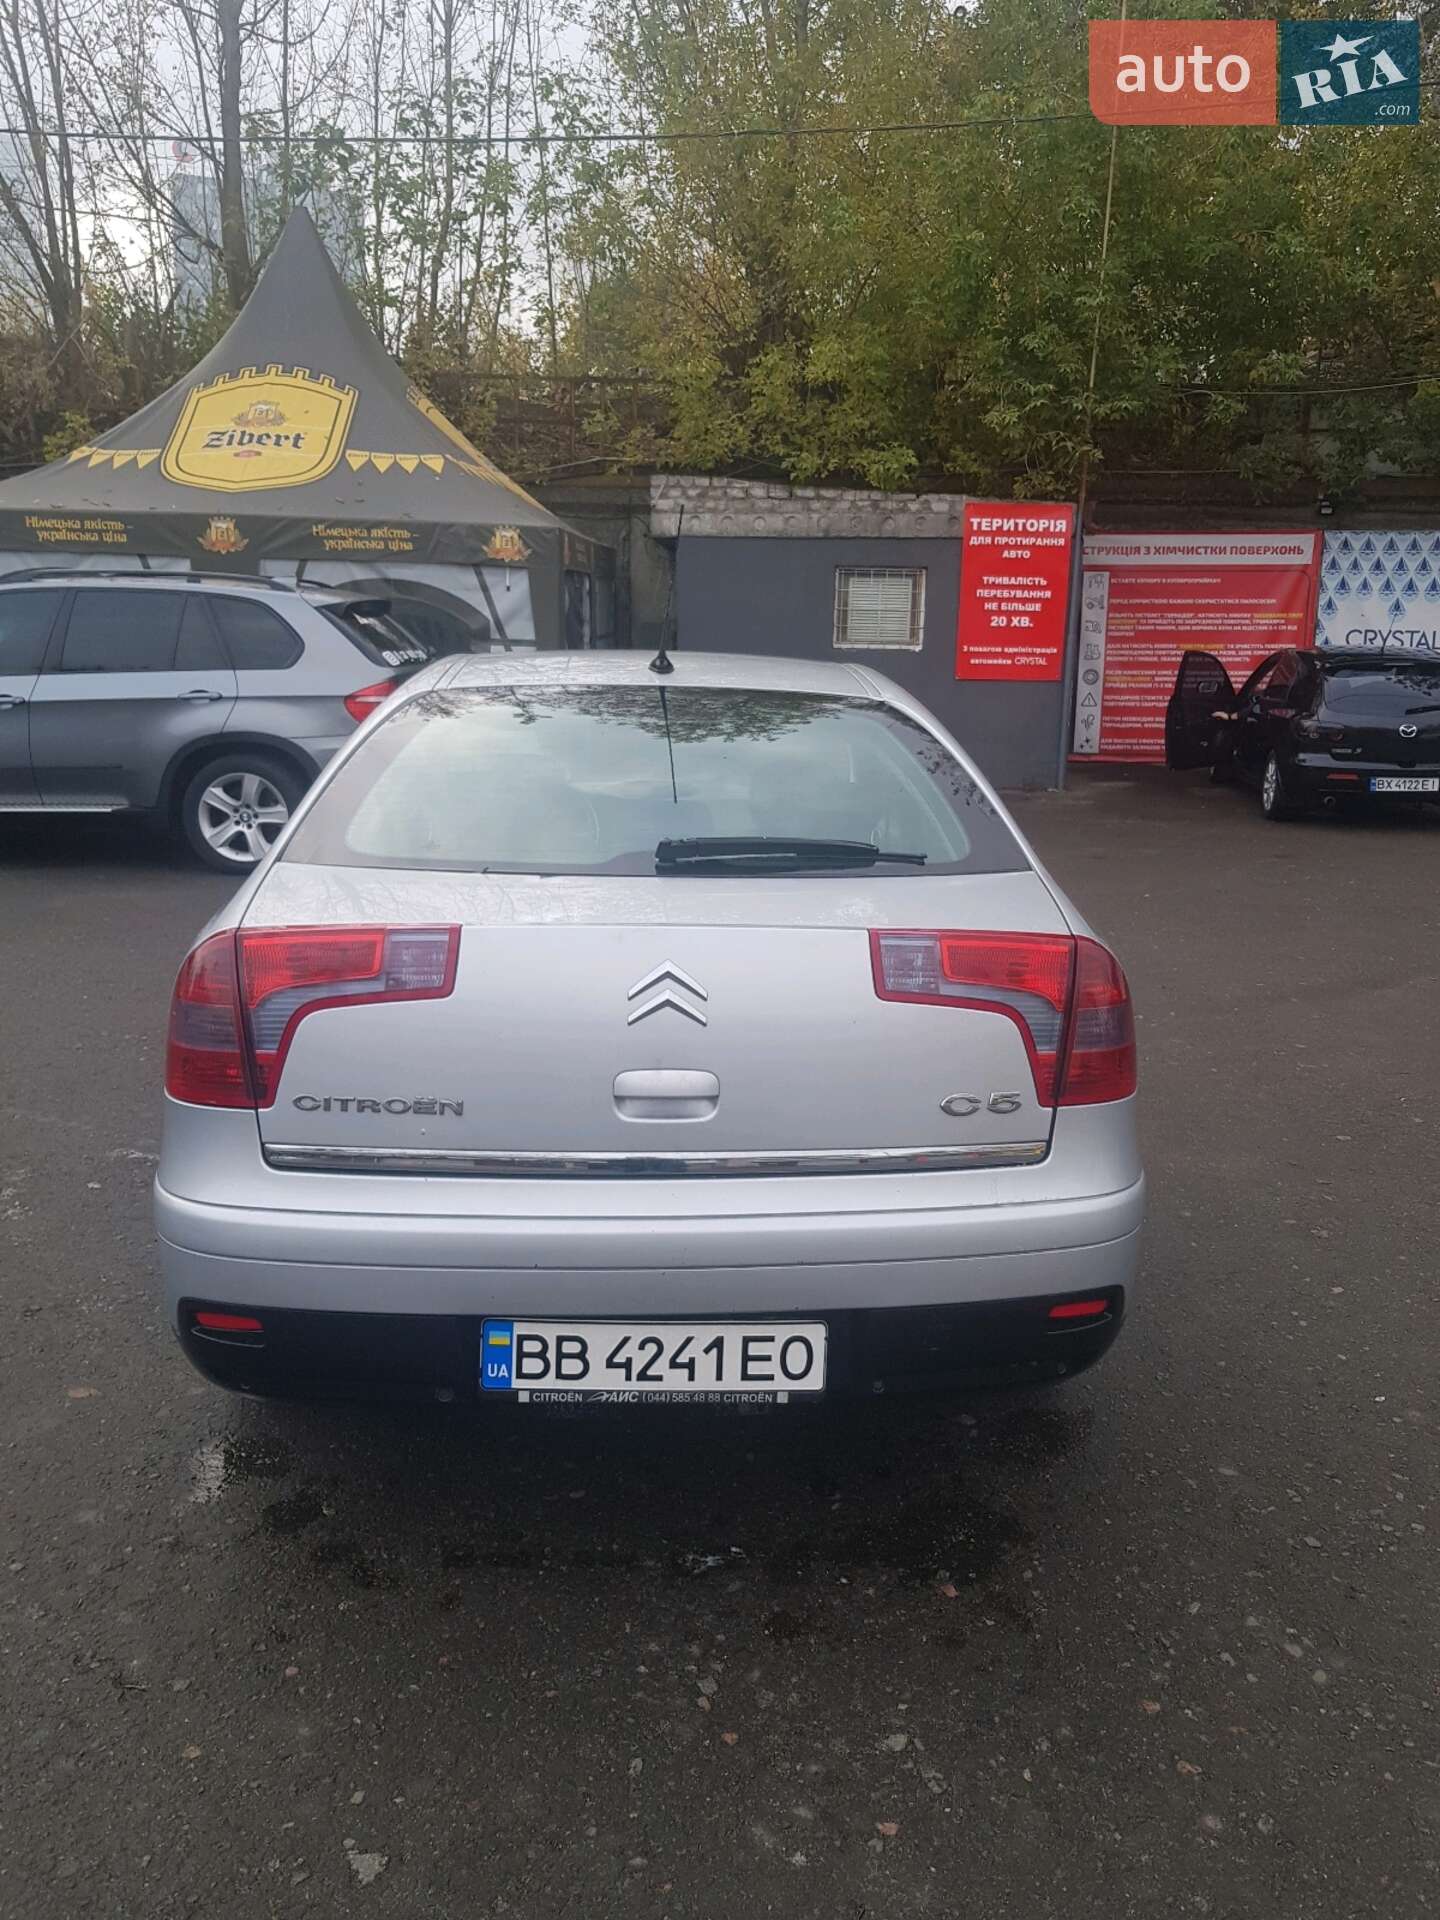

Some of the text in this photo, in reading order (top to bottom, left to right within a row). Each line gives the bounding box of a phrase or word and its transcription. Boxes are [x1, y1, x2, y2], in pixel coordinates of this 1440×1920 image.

[202, 430, 304, 450] Zibert
[24, 515, 80, 529] Німецька
[84, 518, 125, 530] якість
[969, 518, 1067, 532] ТЕРИТОРІЯ
[36, 529, 128, 543] українська ціна
[312, 524, 368, 537] Німецька
[370, 527, 411, 538] якість
[323, 538, 413, 552] українська ціна
[969, 536, 1065, 546] ДЛЯ ПРОТИРАННЯ
[1002, 550, 1031, 559] АВТО
[1082, 545, 1304, 557] СТРУКЦІЯ З ХІМЧИСТКИ ПОВЕРХОНЬ
[982, 576, 1048, 586] ТРИВАЛІСТЬ
[976, 589, 1051, 599] ПЕРЕБУВАННЯ
[984, 602, 1042, 612] НЕ БІЛЬШЕ
[990, 616, 1034, 628] 20 ХВ.
[1345, 629, 1440, 650] CRYSTAL
[1014, 657, 1048, 666] CRYSTAL
[1377, 779, 1393, 791] BX
[1394, 779, 1420, 790] 4122
[292, 1093, 465, 1117] CITROËN
[940, 1091, 1023, 1117] C5
[515, 1333, 814, 1382] BB 4241 EO
[487, 1363, 509, 1378] UA
[532, 1391, 583, 1402] CITROËN
[671, 1392, 691, 1402] 585
[692, 1392, 705, 1402] 48
[723, 1391, 773, 1403] CITROËN
